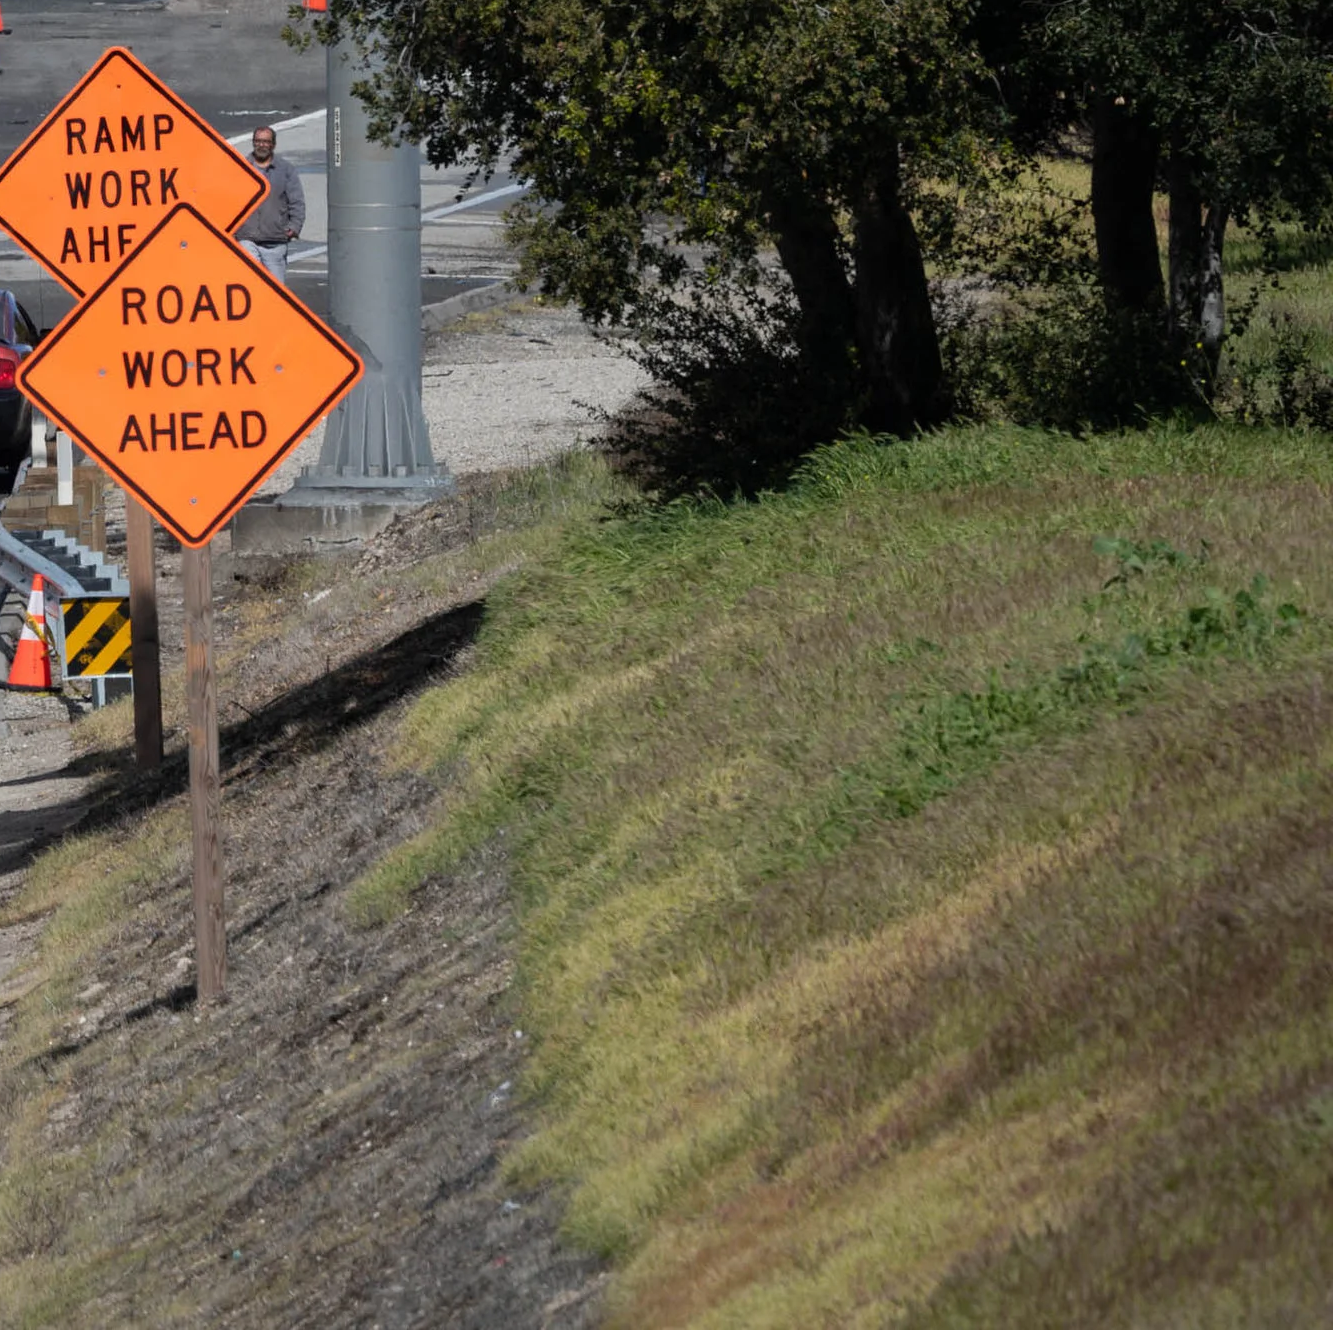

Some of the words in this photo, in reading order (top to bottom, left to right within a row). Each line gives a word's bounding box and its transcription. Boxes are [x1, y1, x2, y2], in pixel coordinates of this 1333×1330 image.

[65, 113, 174, 155] RAMP
[65, 168, 180, 210] WORK
[60, 223, 137, 264] AHE
[122, 283, 252, 325] ROAD
[122, 347, 256, 389] WORK
[119, 410, 267, 453] AHEAD
